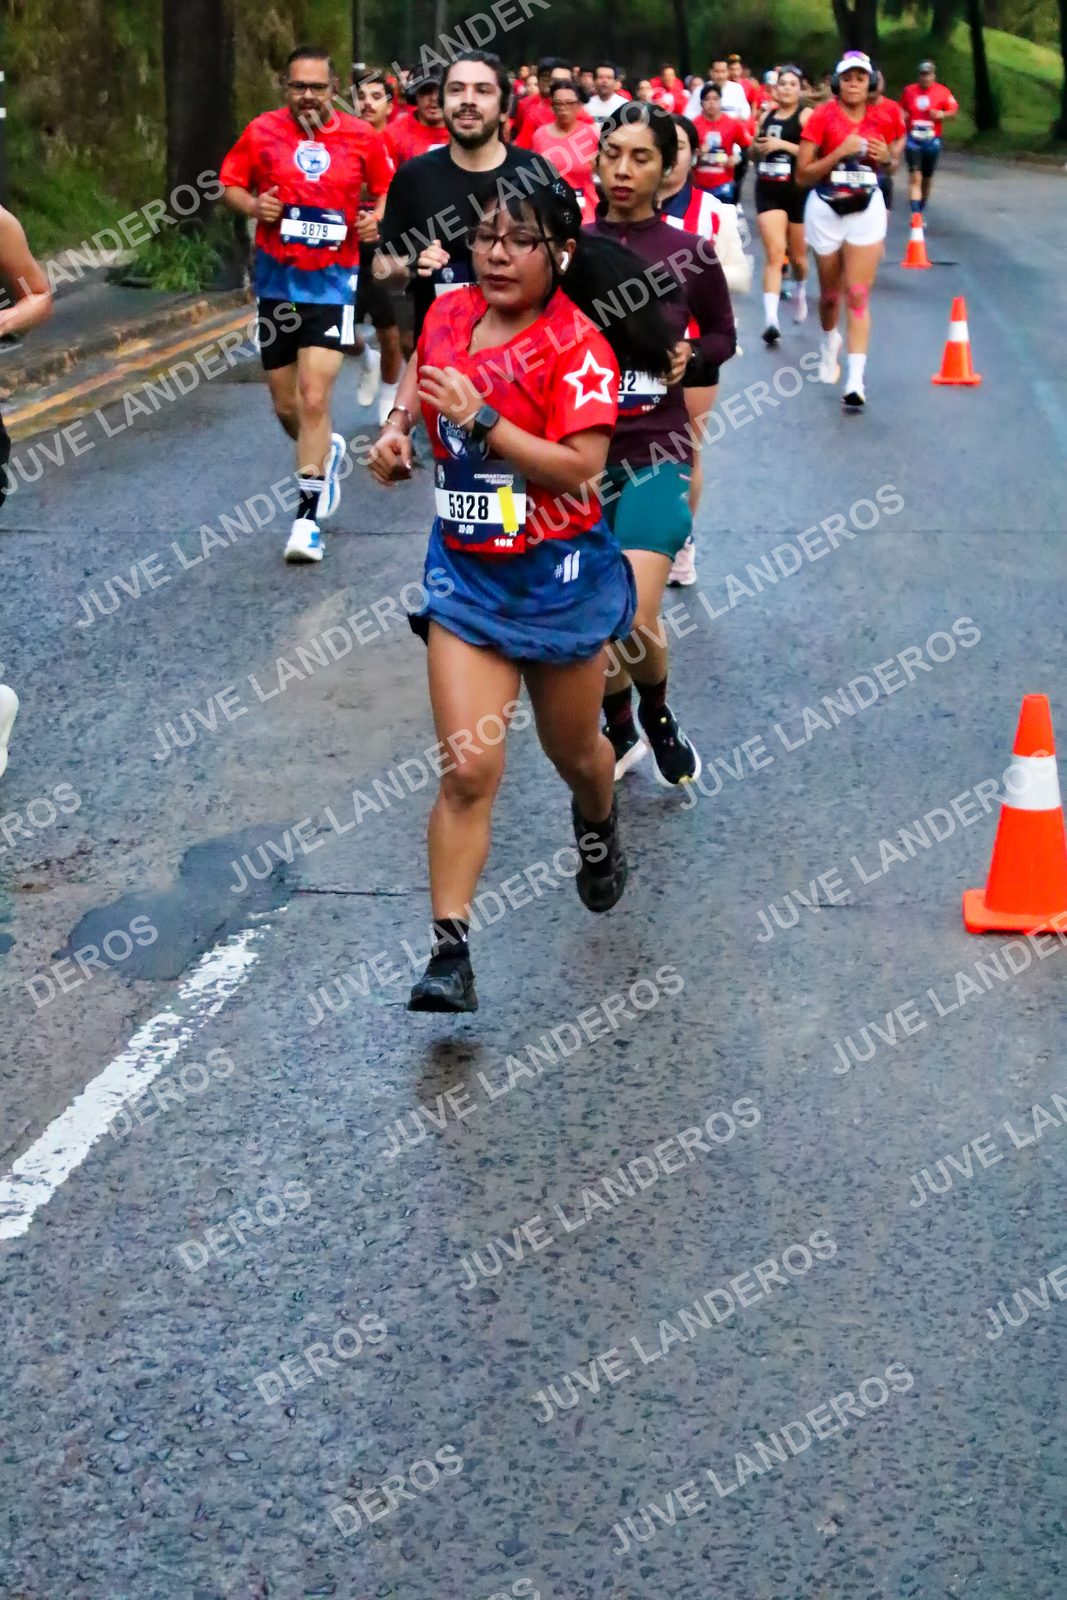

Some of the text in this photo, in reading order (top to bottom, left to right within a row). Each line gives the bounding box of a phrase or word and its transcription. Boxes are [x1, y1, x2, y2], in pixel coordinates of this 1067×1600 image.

[301, 222, 329, 238] 3879
[448, 493, 489, 520] 5328
[493, 538, 514, 547] 10K
